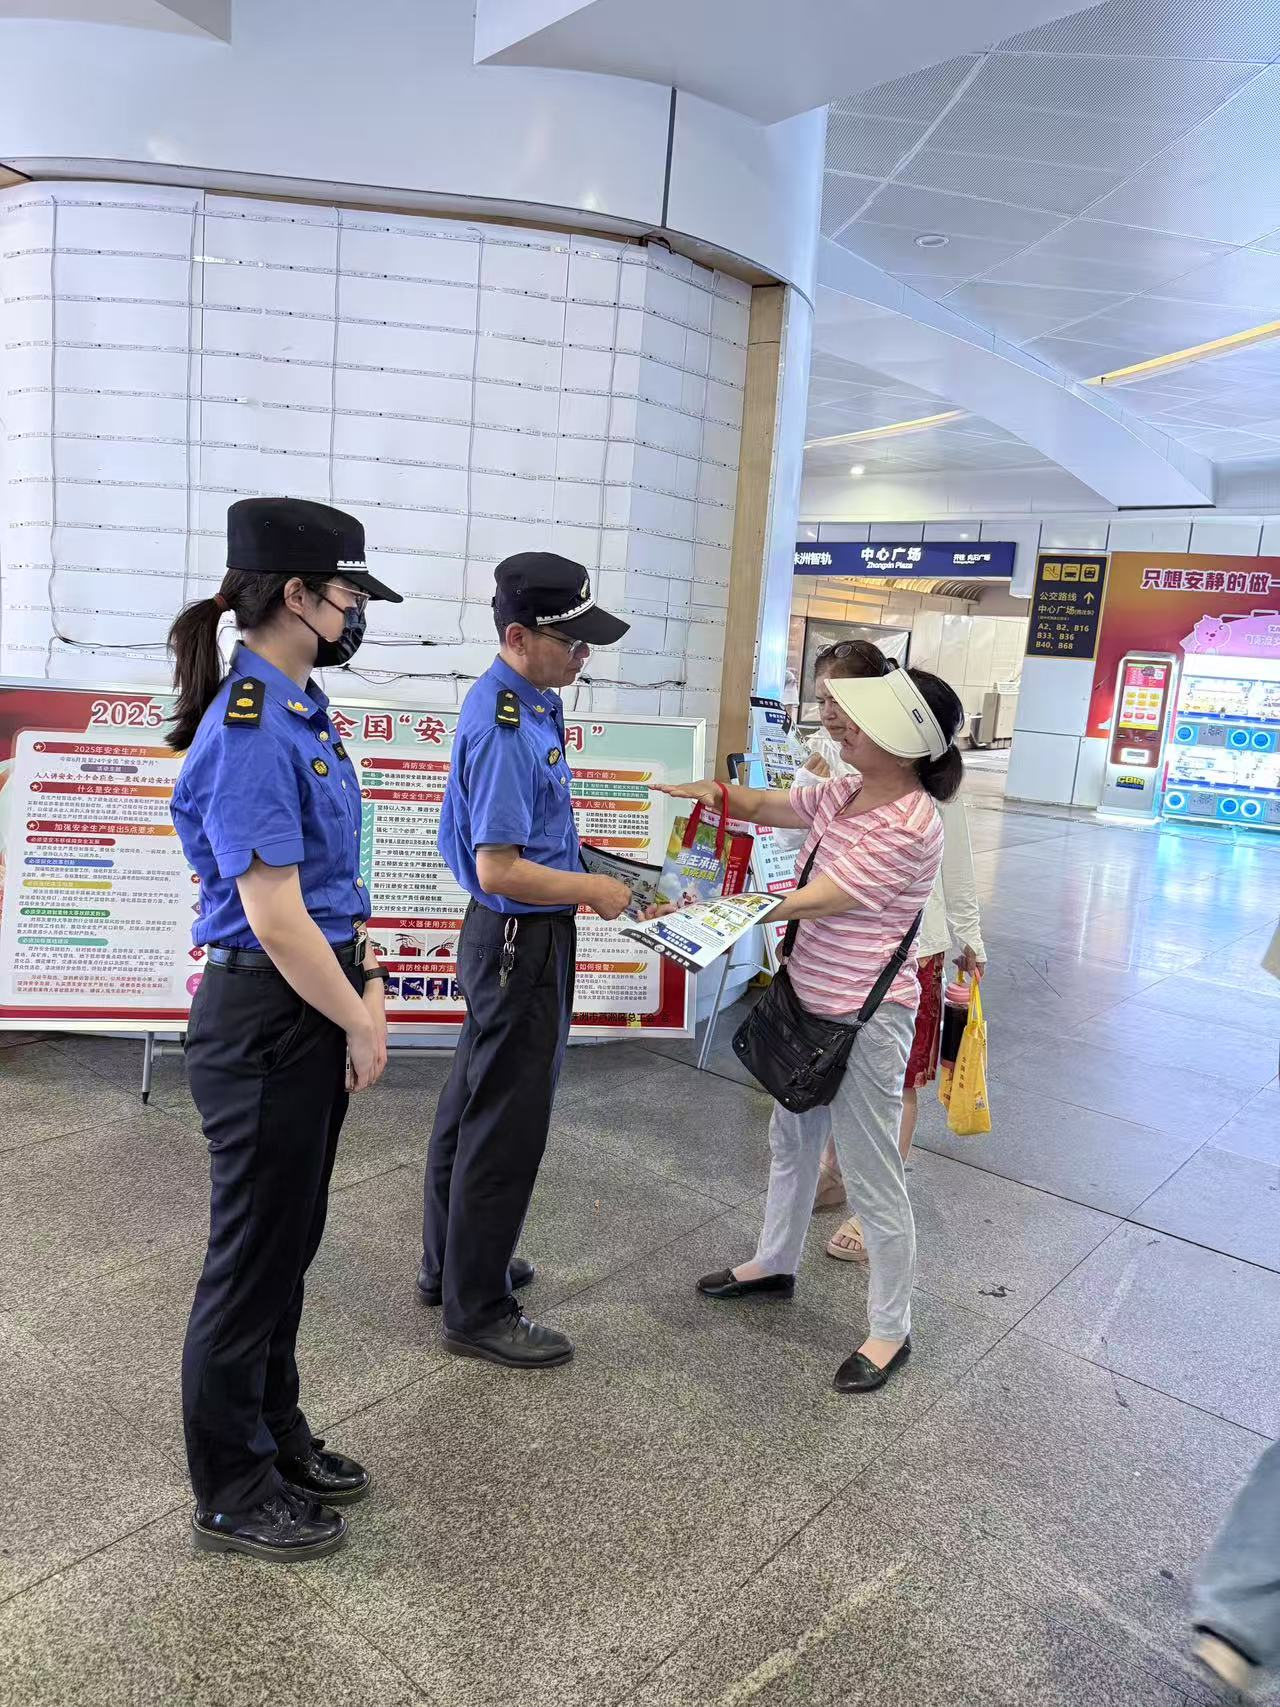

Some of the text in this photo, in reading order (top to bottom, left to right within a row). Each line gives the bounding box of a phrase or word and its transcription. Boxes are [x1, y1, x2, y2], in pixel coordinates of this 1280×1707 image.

[860, 547, 922, 562] 中心广场
[866, 561, 914, 570] Zhongxin Plaza
[1039, 591, 1077, 602] 公交路线
[92, 701, 163, 727] 2025
[331, 710, 458, 744] 全国“安
[74, 745, 147, 756] 2025年安全生产月
[77, 785, 138, 795] 什么是安全生产
[585, 801, 616, 809] 八安八险
[54, 823, 156, 834] 加强安全生产提出5点要求
[399, 920, 456, 929] 灭火器使用方法
[397, 964, 455, 972] 消防栓使用方法
